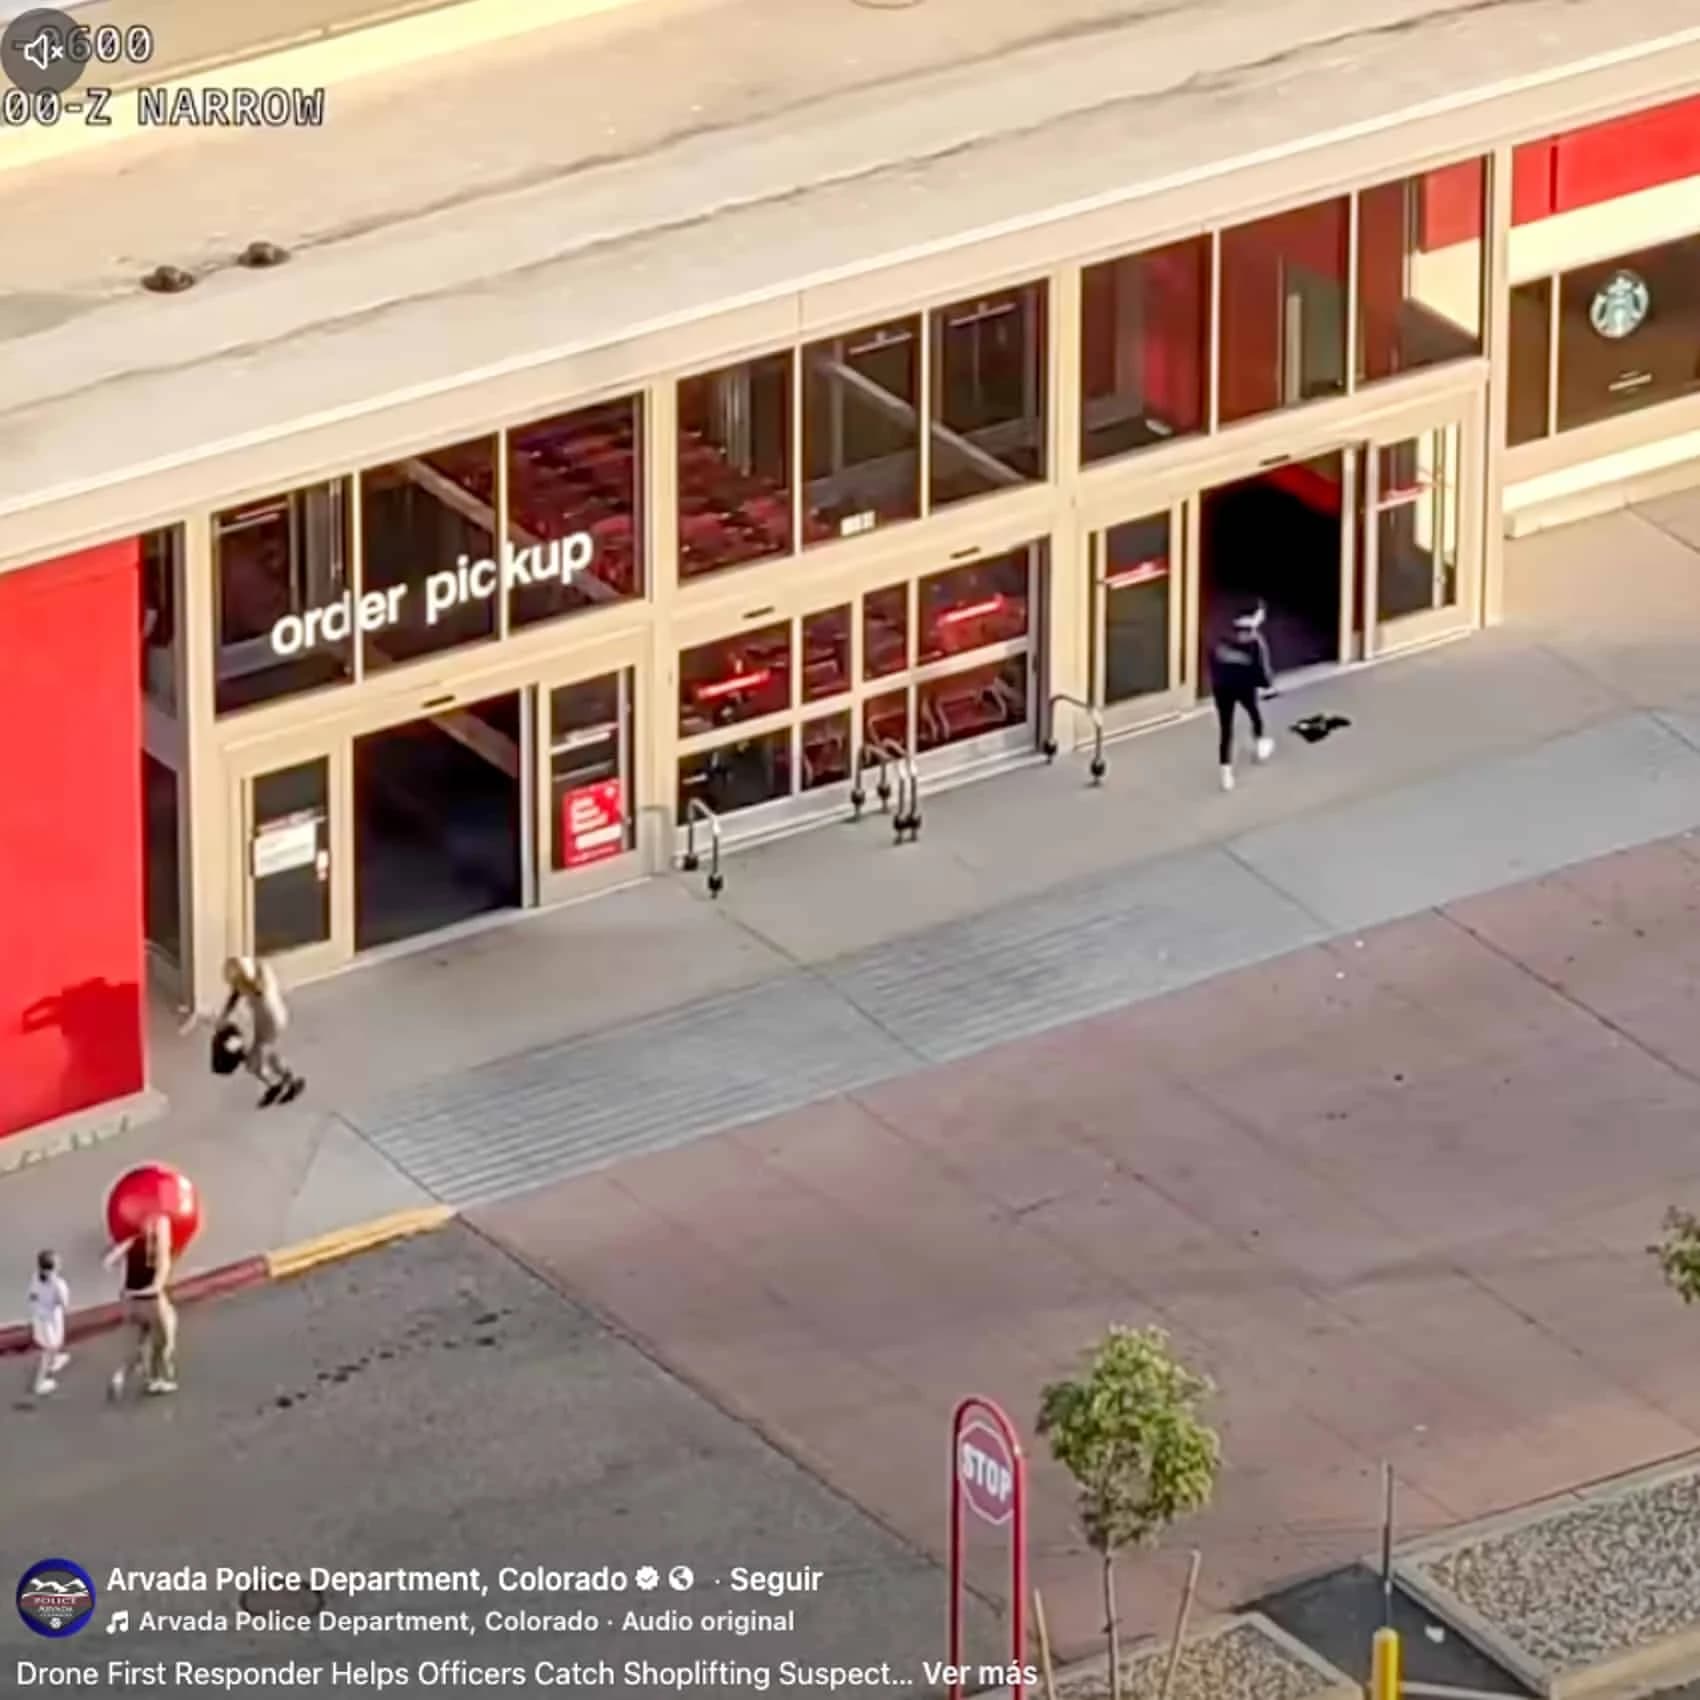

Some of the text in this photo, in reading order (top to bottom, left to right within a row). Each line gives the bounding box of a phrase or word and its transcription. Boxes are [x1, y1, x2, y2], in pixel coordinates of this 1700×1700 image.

[271, 532, 593, 655] order pickup
[962, 1442, 1012, 1501] STOP
